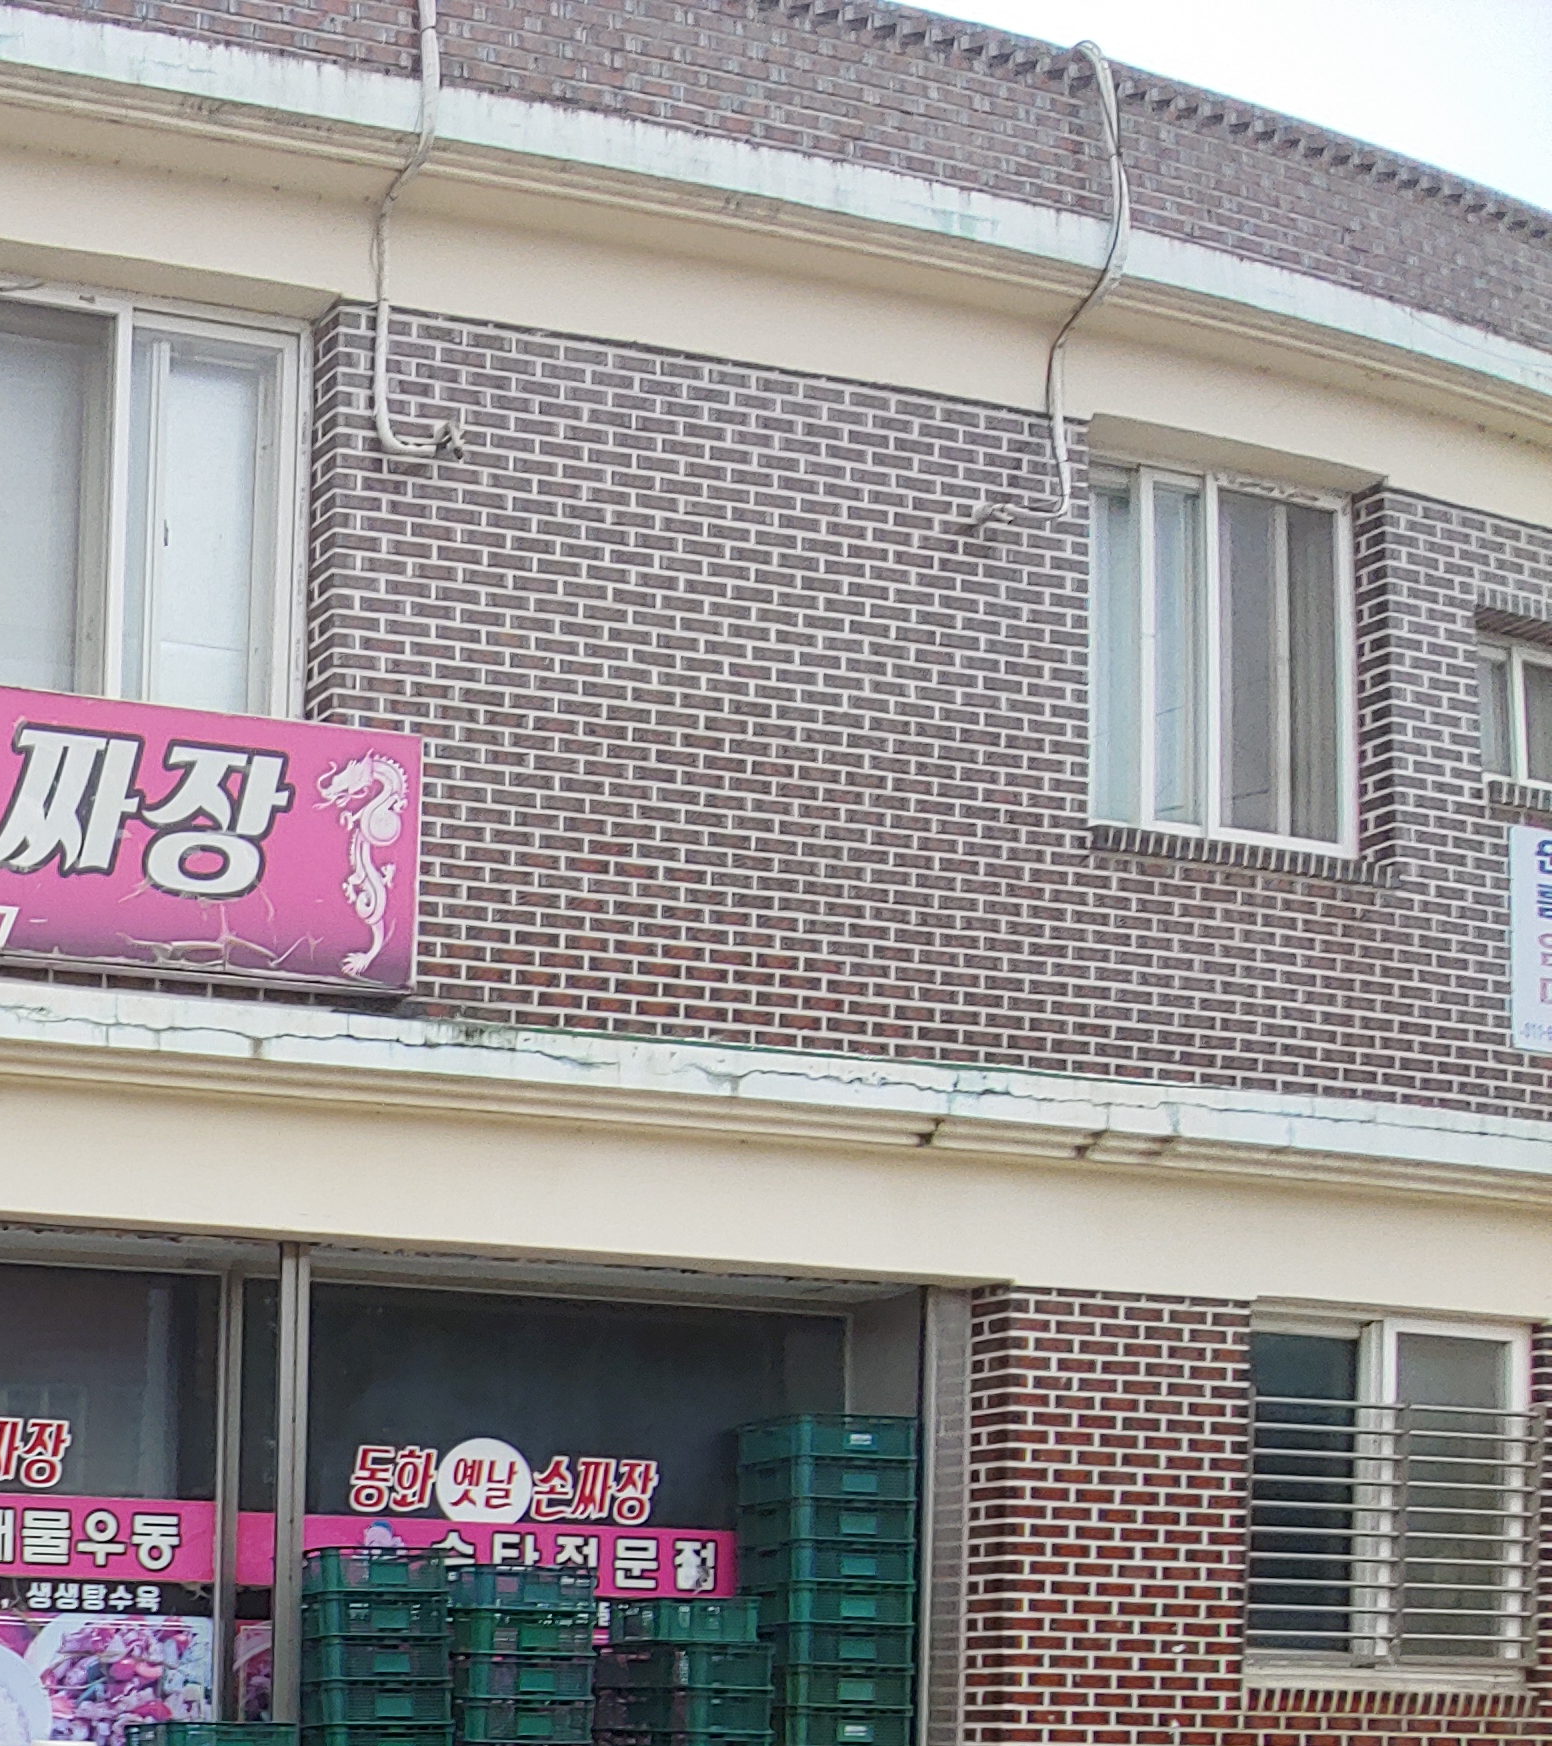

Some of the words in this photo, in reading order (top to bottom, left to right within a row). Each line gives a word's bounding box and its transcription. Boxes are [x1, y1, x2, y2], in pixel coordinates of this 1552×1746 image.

[349, 1444, 438, 1512] 동화
[449, 1456, 518, 1510] 옛날
[531, 1456, 660, 1525] 손짜장
[26, 1581, 161, 1612] 생생탕수육
